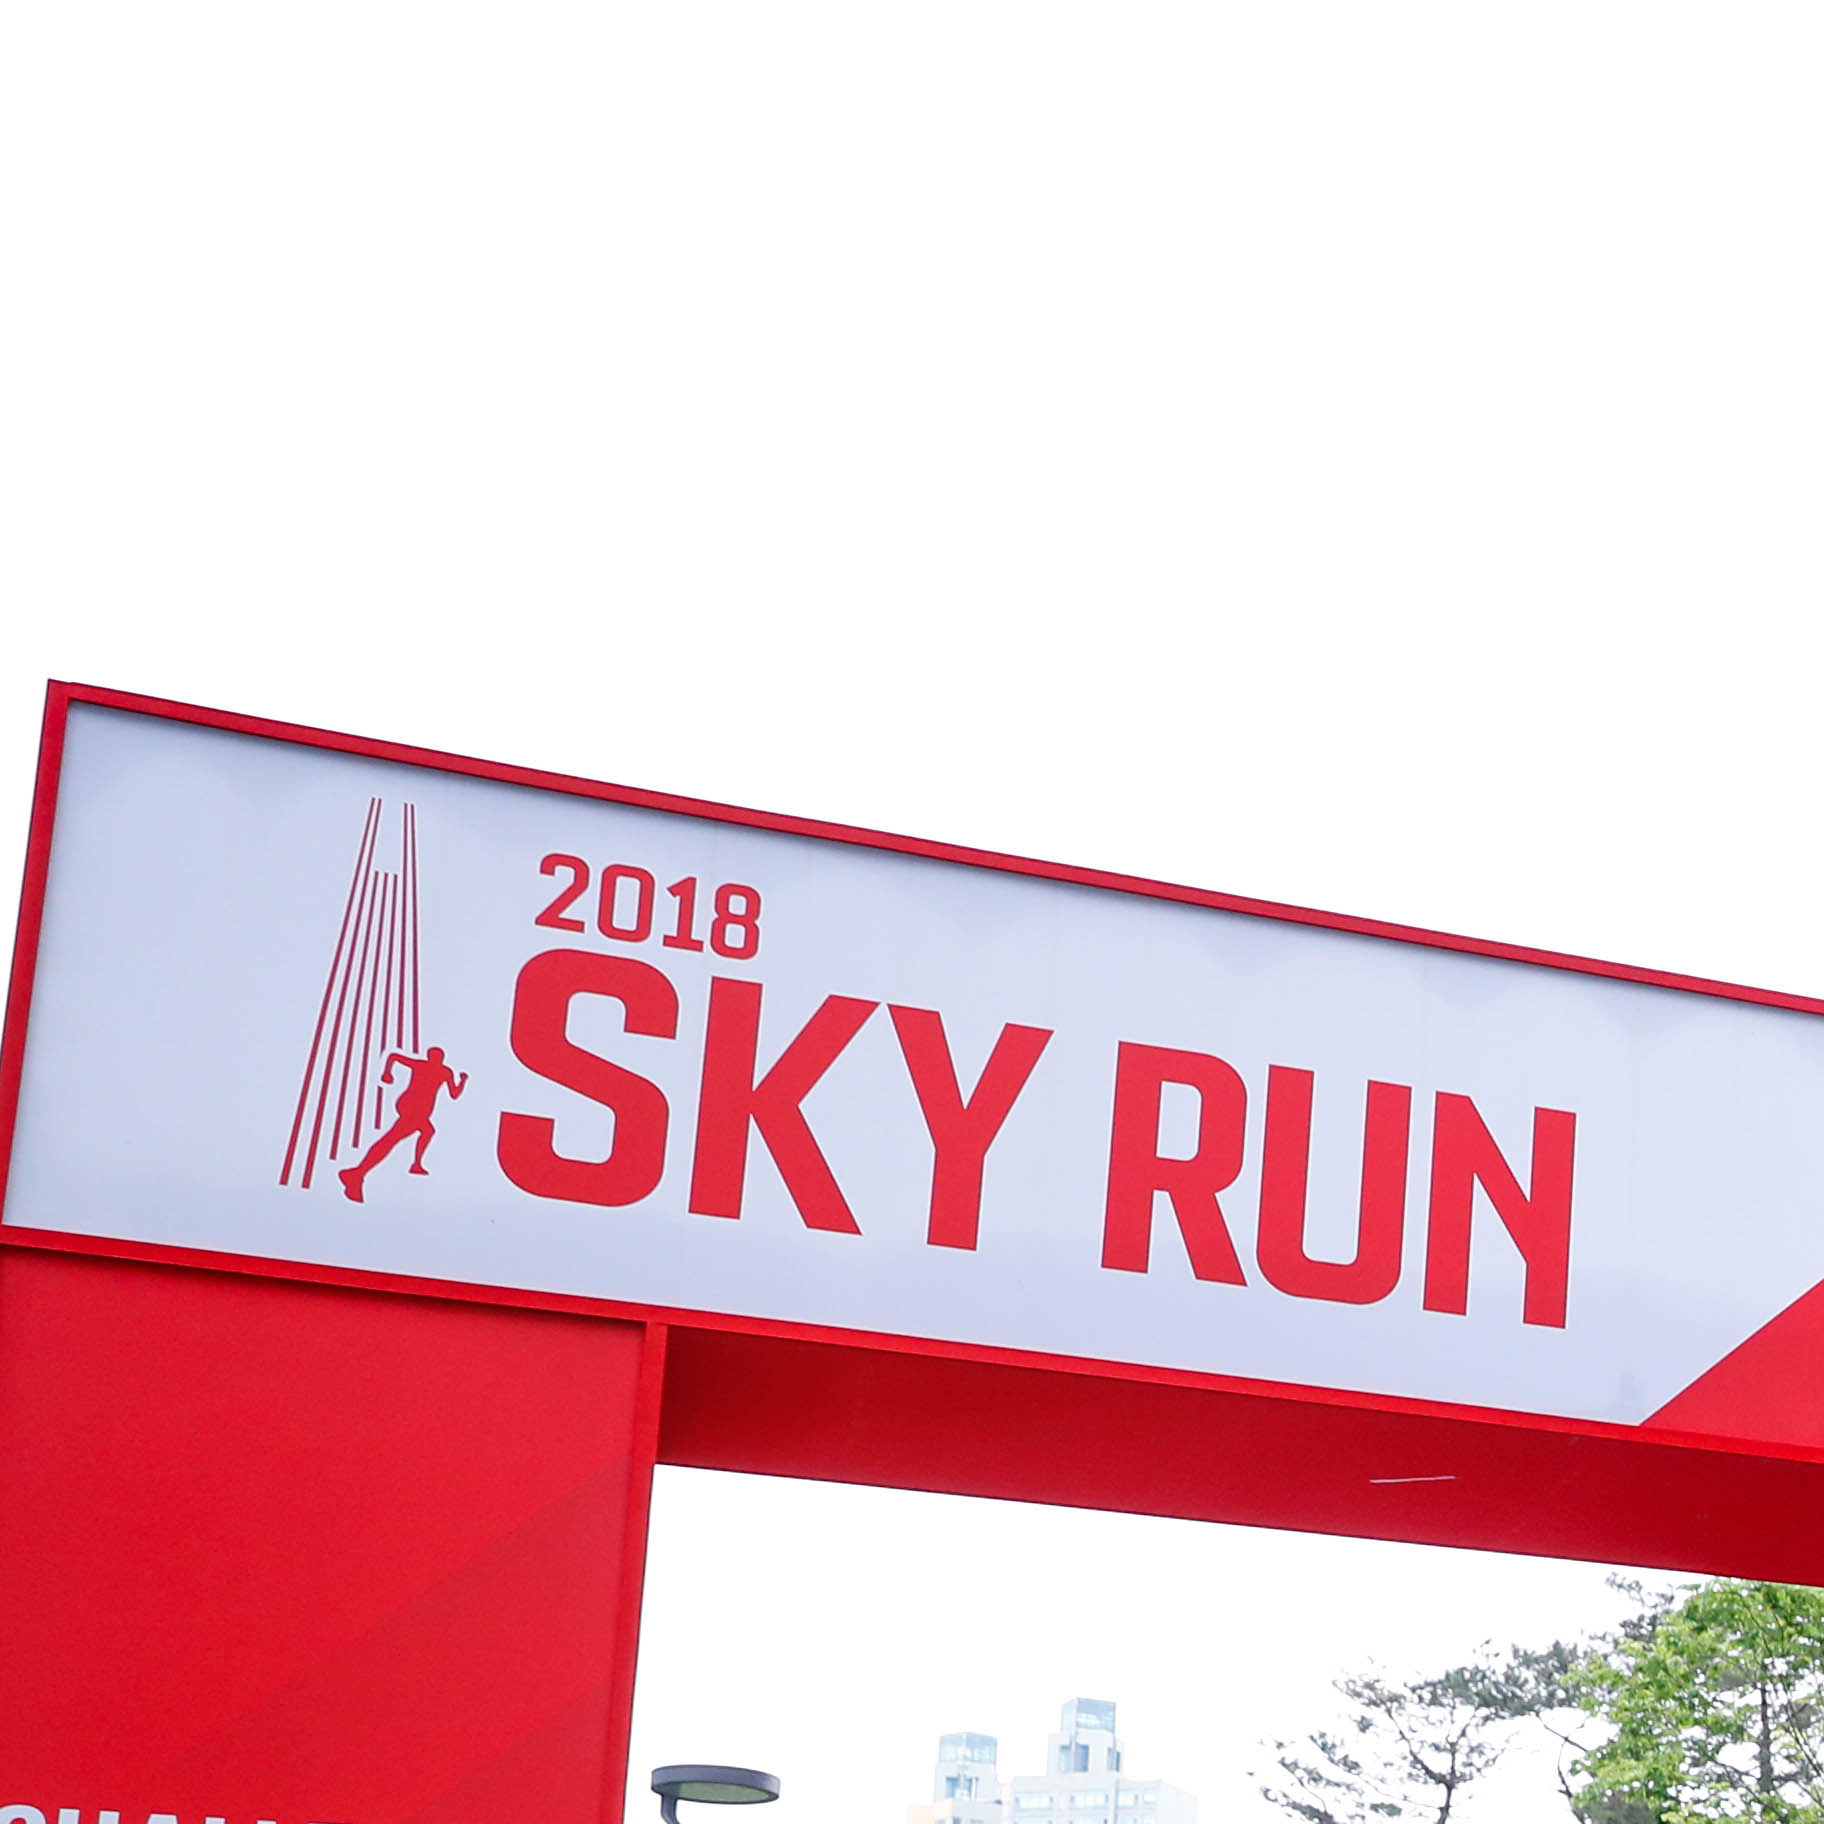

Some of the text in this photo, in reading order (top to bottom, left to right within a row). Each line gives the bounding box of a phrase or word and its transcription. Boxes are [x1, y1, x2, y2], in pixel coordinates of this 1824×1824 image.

[535, 852, 762, 962] 2018
[497, 948, 1578, 1330] SKY RUN
